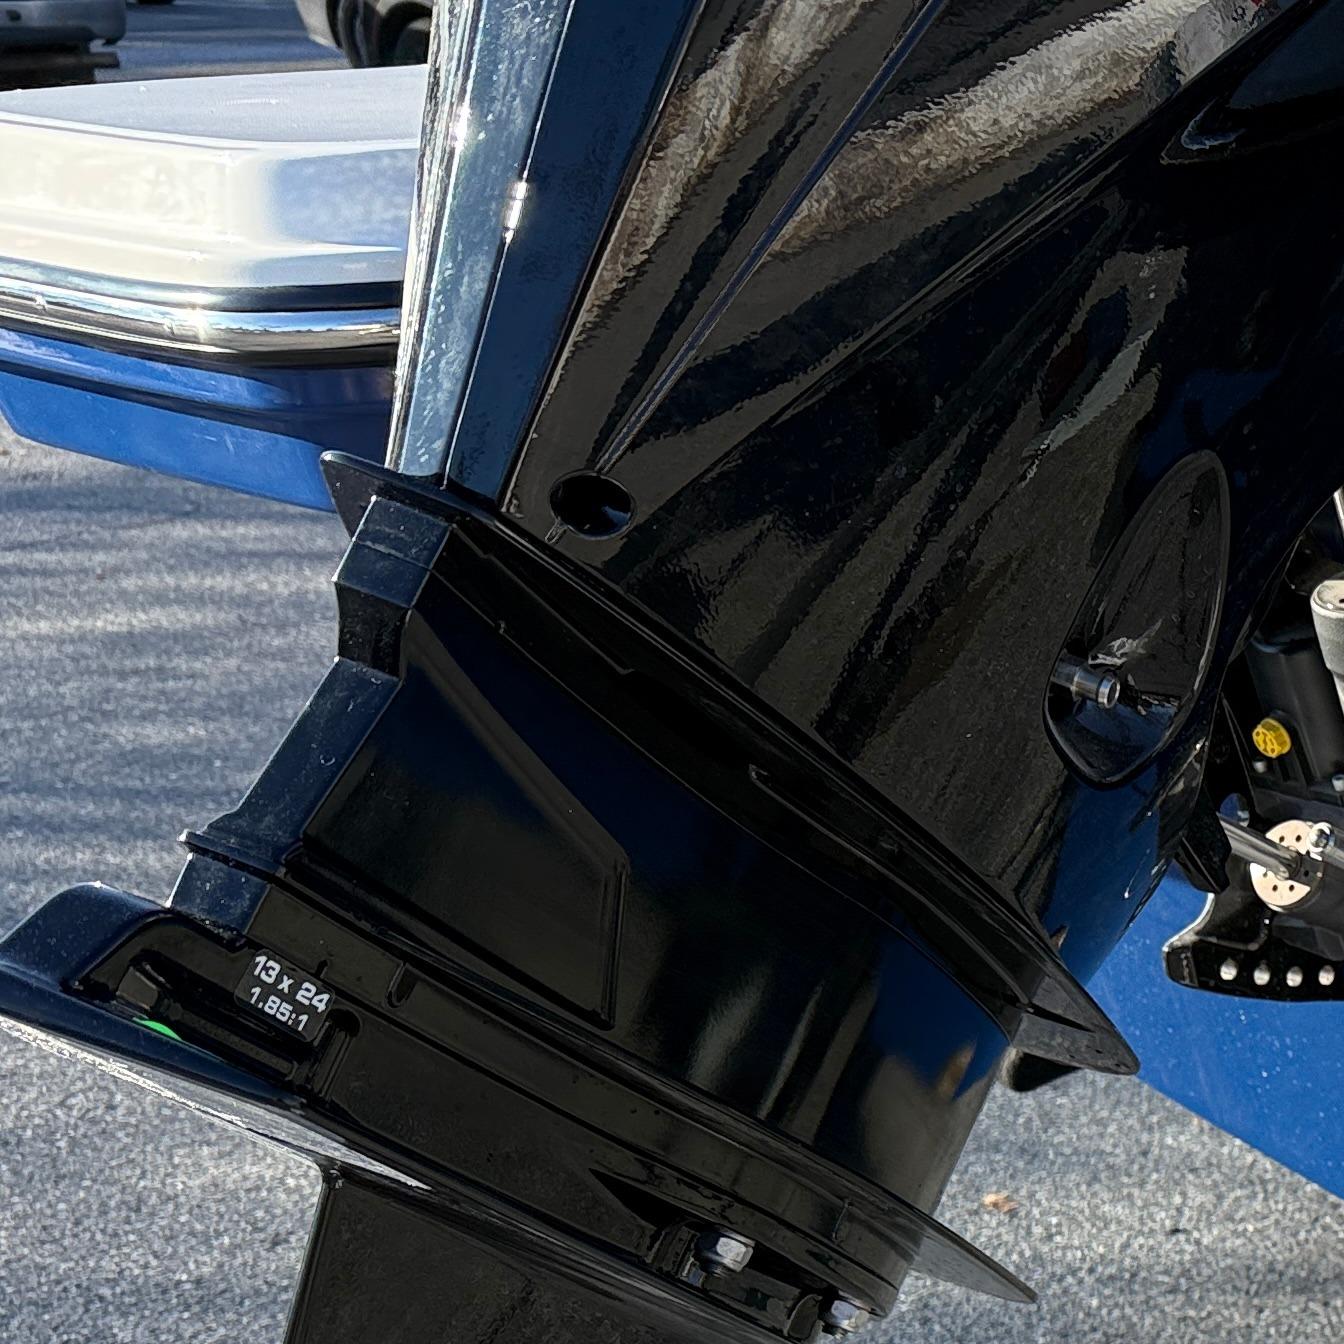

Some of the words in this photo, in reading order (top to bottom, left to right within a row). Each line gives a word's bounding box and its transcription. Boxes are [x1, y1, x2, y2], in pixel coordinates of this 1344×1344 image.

[250, 986, 308, 1032] 1.85:1
[254, 956, 281, 984] 13
[296, 982, 330, 1013] 24
